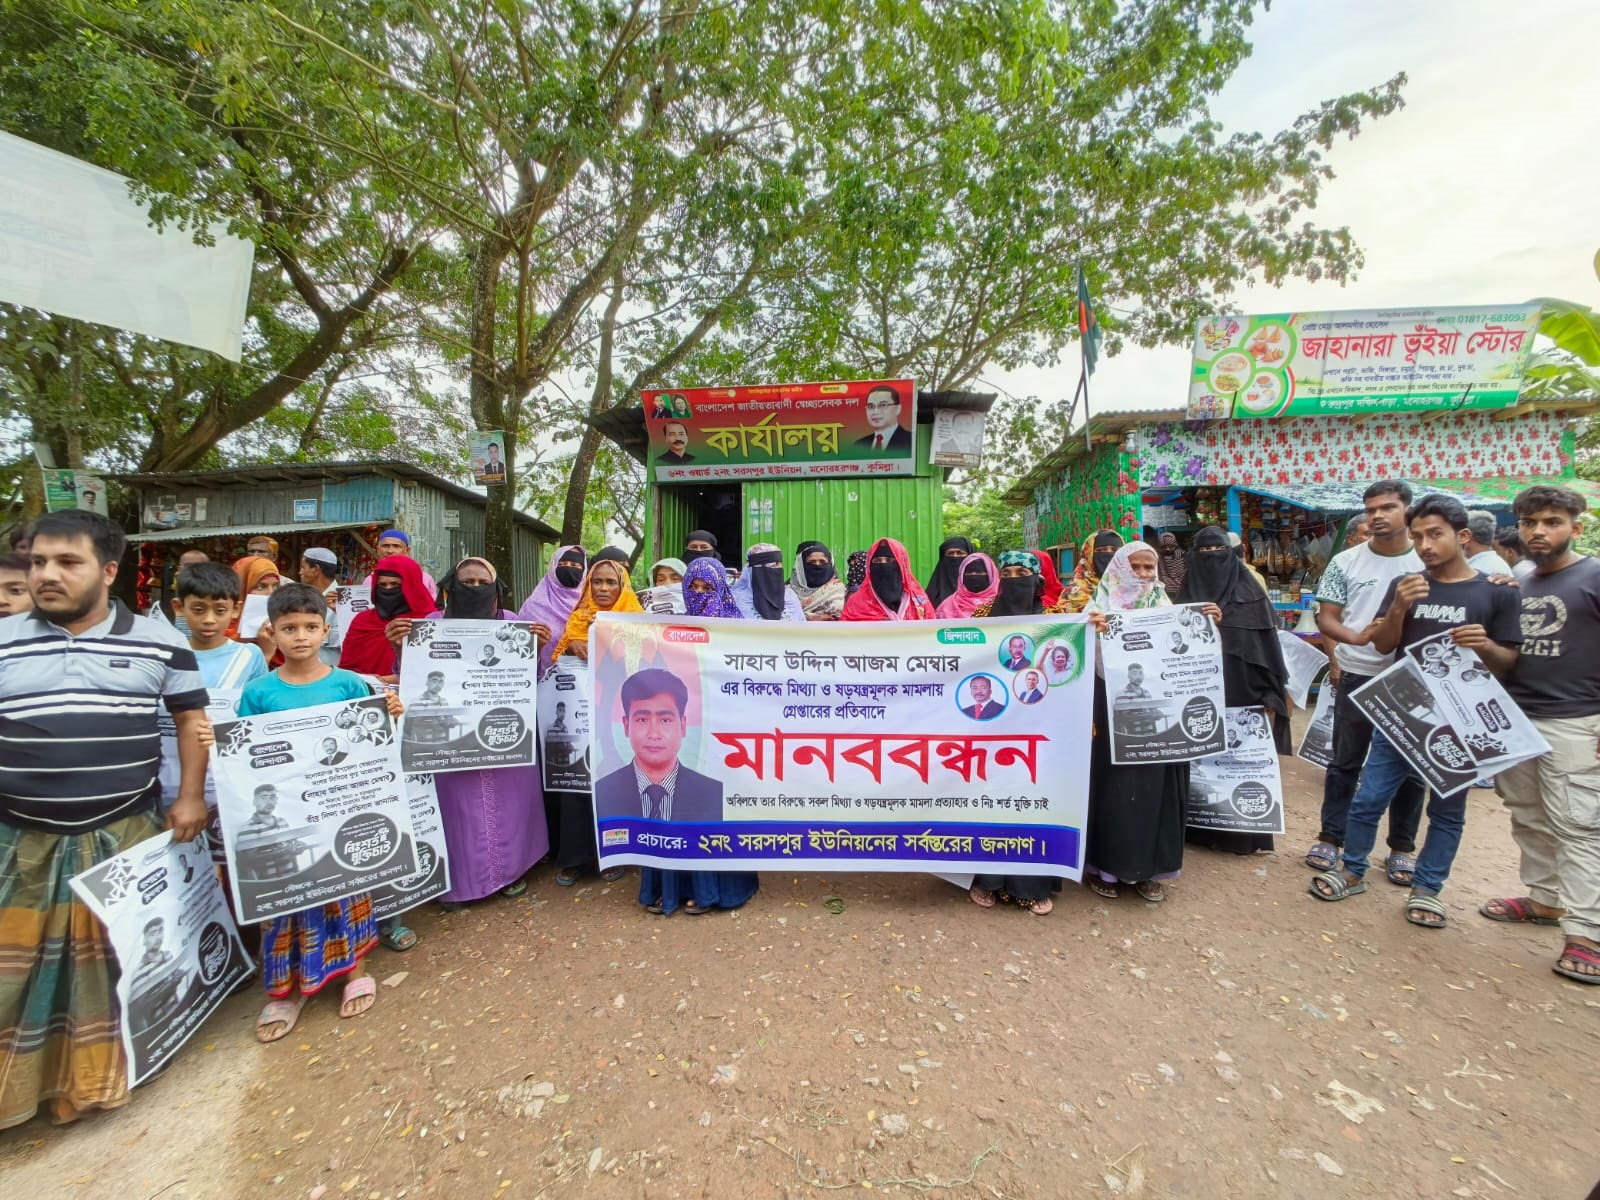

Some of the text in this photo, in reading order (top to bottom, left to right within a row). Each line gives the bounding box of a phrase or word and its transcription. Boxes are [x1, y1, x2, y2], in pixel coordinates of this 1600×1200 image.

[1301, 323, 1528, 363] জাহানারা ভূঁইয়া স্টোর
[696, 398, 859, 413] বাংলাদেশ জাতীয়তাবাদী স্বেচ্ছাসেবক দল
[699, 412, 845, 458] কার্যালয়
[1414, 604, 1466, 623] PUMA
[668, 631, 705, 641] বাংলাদেশ
[944, 629, 979, 641] জিন্দাবাদ
[1521, 639, 1561, 656] CCI
[724, 650, 960, 672] সাহাব উদ্দিন আজম মেম্বার
[721, 678, 944, 701] এর বিরুদ্ধে মিথ্যা ও ষড়যন্ত্রমূলক মামলায়
[783, 702, 886, 719] গ্রেপ্তারের প্রতিবাদে
[254, 742, 289, 755] বাংলাদেশ
[711, 728, 1050, 785] মানববন্ধন
[255, 755, 288, 768] জিন্দাবাদ
[726, 794, 1049, 812] অবিলম্বে তার বিরুদ্ধে সকল মিথ্যা ও ষড়যন্ত্রমূলক মামলা প্রত্যাহার ও নিঃ শর্ত মুক্তি চাই
[698, 835, 733, 854] ২নং
[737, 833, 803, 856] সরসপুর
[808, 829, 898, 852] ইউনিয়নের
[903, 829, 974, 853] সর্বস্তরের
[979, 836, 1035, 855] জনগণ
[275, 895, 304, 908] সরসপুর
[305, 881, 346, 899] ইউনিয়নের
